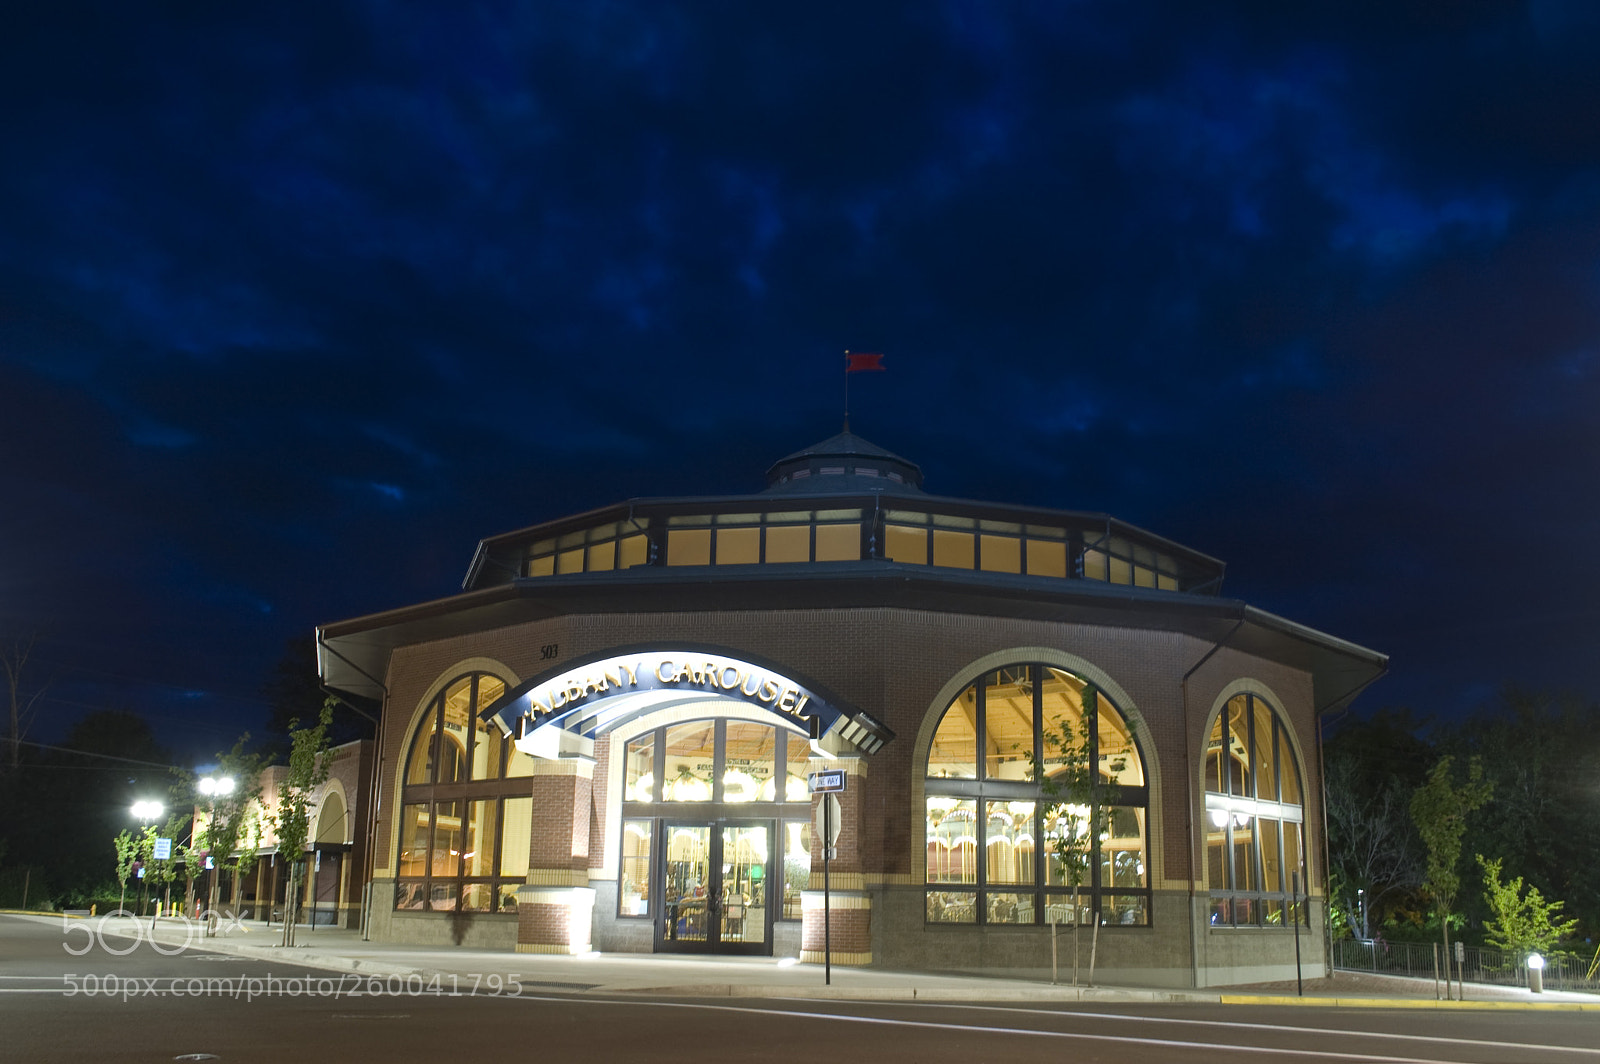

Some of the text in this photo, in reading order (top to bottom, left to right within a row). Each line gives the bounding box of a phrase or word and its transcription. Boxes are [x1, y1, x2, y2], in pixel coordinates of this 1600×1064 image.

[540, 644, 558, 660] 503
[525, 660, 811, 722] ALBANY CAROUSEL
[827, 775, 839, 785] WAY
